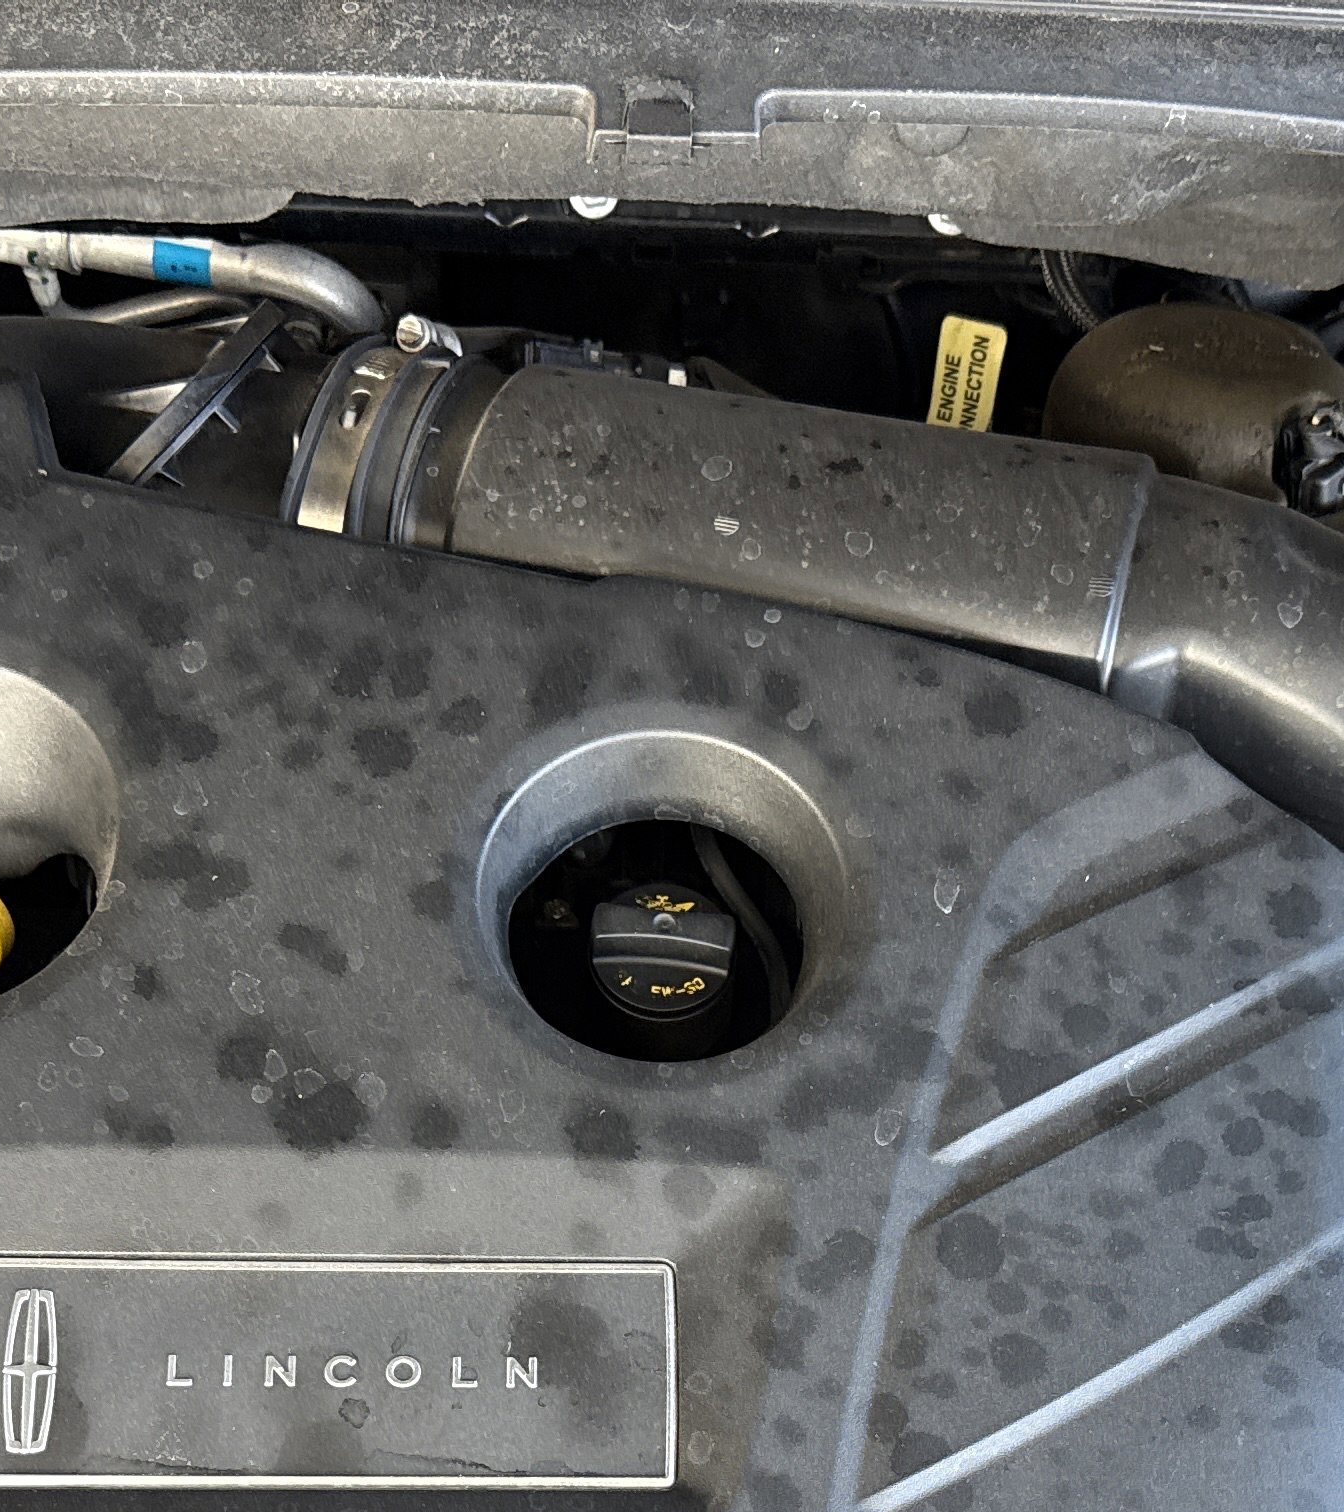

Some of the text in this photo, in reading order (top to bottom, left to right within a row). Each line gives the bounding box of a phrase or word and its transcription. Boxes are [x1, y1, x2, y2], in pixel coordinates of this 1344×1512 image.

[936, 354, 961, 423] ENGINE
[959, 335, 990, 431] NNECTION
[165, 1353, 539, 1389] LINCOLN
